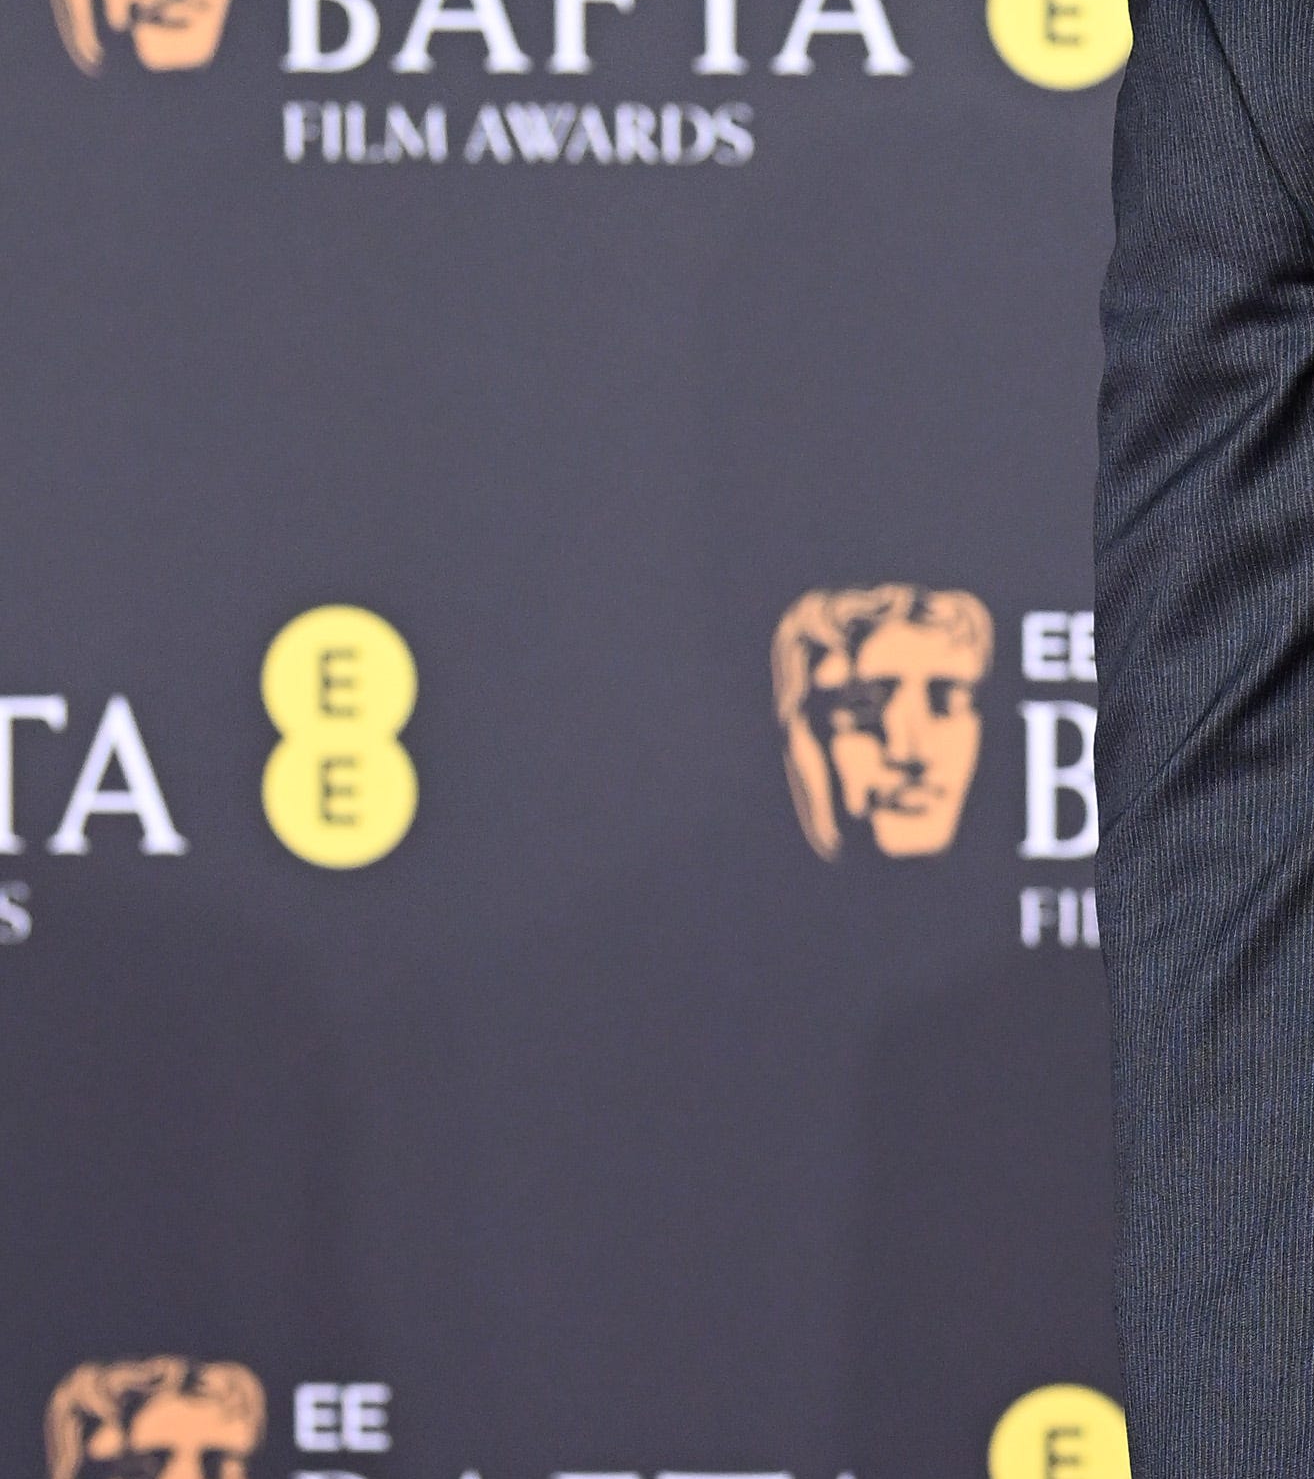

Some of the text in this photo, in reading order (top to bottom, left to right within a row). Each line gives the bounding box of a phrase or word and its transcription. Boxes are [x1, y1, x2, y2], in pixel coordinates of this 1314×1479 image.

[283, 102, 754, 164] FILM AWARDS
[294, 1383, 390, 1452] EE
